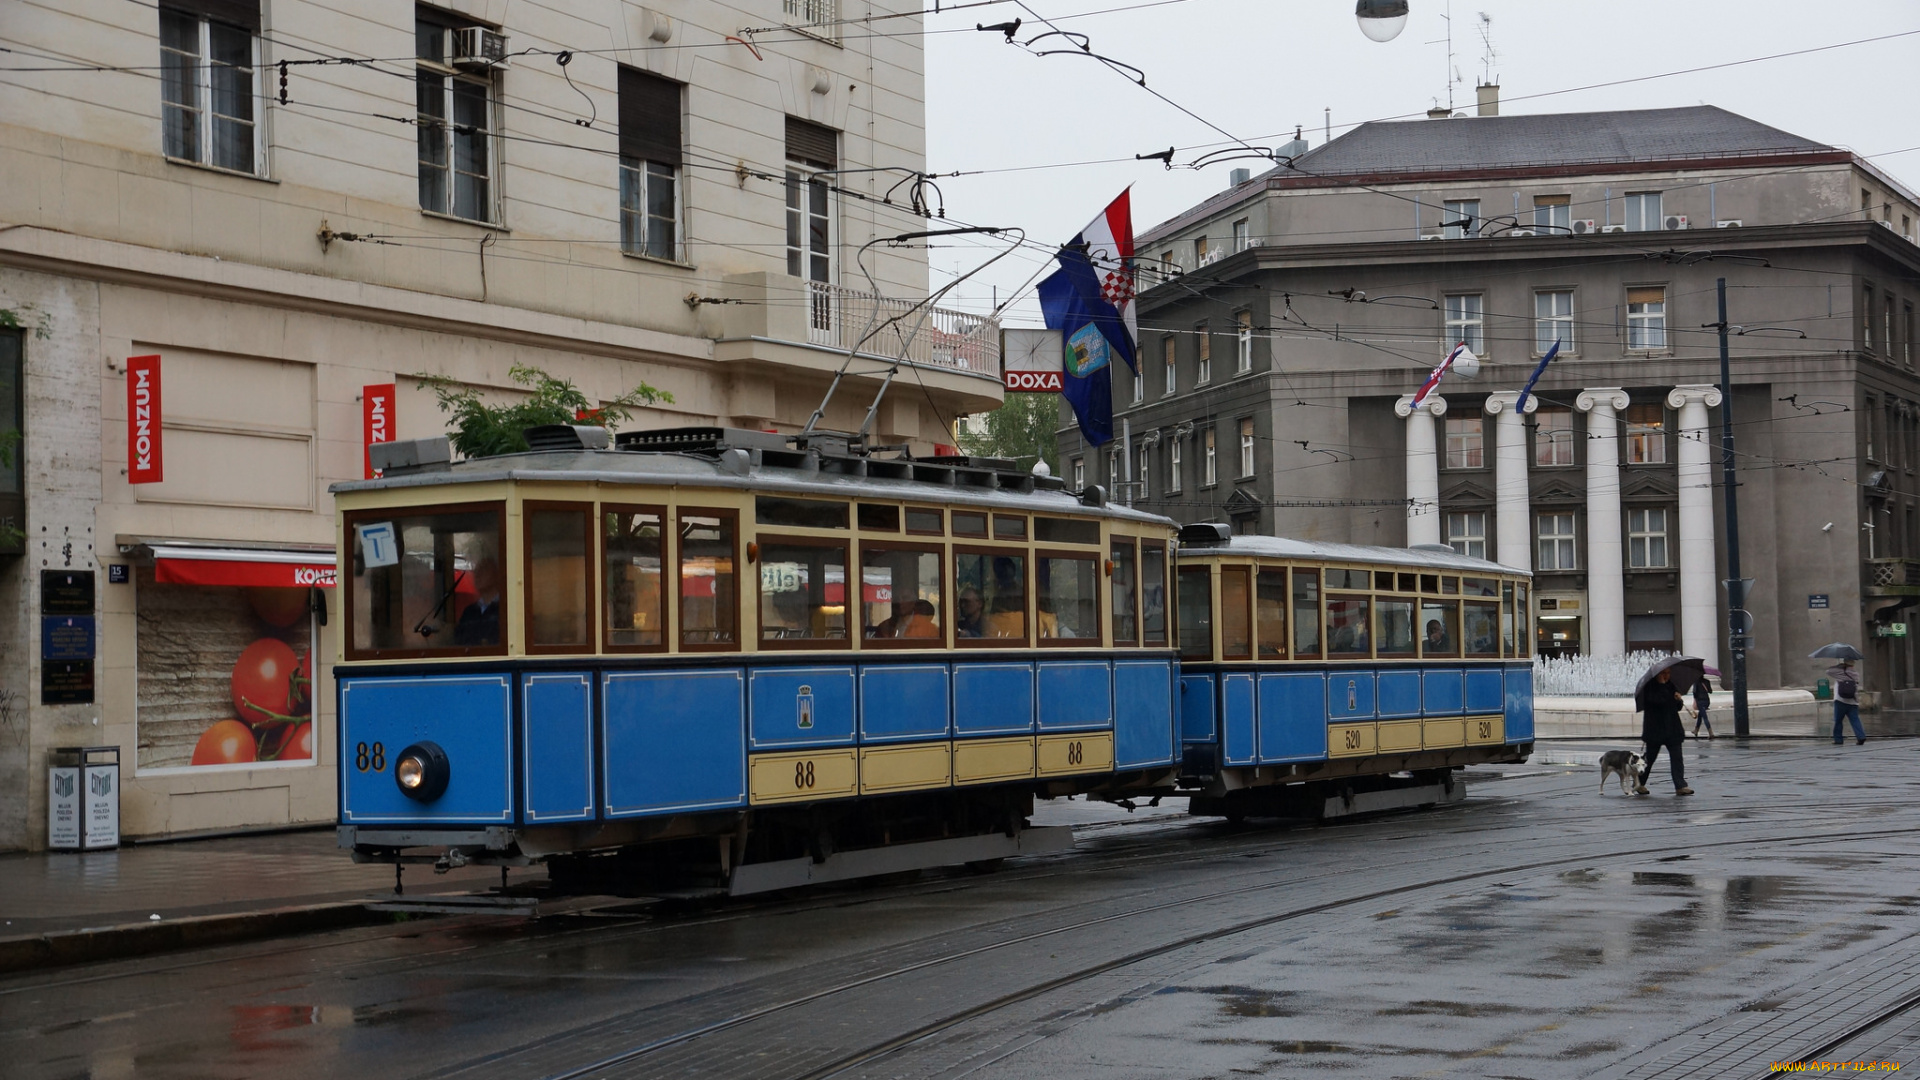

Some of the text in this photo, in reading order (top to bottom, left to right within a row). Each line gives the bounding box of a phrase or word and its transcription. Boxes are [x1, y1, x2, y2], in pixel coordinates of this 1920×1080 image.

[1007, 373, 1062, 389] DOXA
[136, 369, 151, 470] KONZUM
[363, 527, 390, 562] T
[112, 566, 122, 576] 15
[295, 568, 337, 585] KONZ
[1345, 730, 1361, 750] 520
[1478, 721, 1492, 739] 520
[356, 741, 386, 772] 88
[1068, 741, 1082, 765] 88
[795, 760, 815, 789] 88
